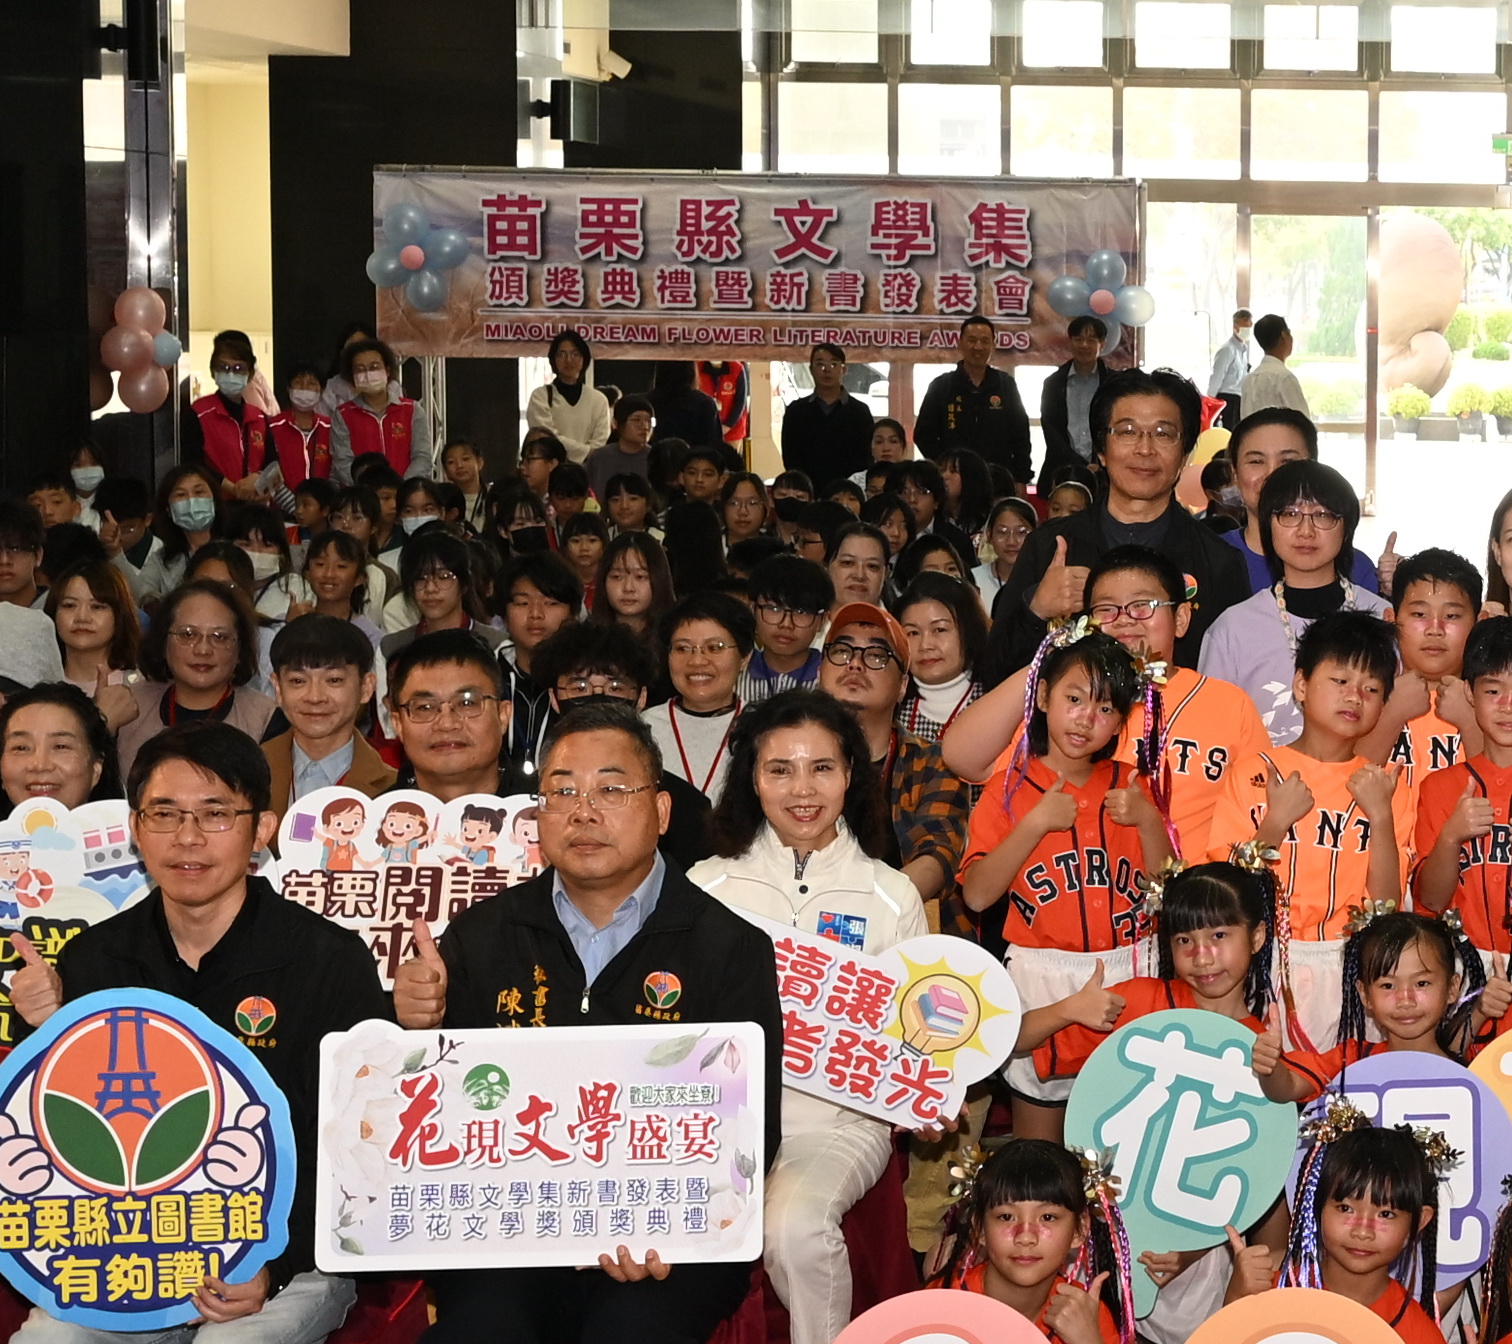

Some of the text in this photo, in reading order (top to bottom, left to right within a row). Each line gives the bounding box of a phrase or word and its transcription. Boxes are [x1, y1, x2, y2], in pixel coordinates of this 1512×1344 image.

[482, 195, 1030, 267] 苗栗縣文學集
[486, 267, 1031, 315] 頒獎典禮暨新書發表會
[579, 324, 658, 344] DREAM
[666, 326, 764, 346] FLOWER
[773, 328, 920, 348] LITERATURE
[285, 865, 548, 923] 苗栗閱讀
[390, 1072, 721, 1170] 花現文學盛宴
[389, 1177, 709, 1209] 苗栗縣文學集新書發表暨
[389, 1207, 709, 1240] 夢花文學獎頒獎典禮
